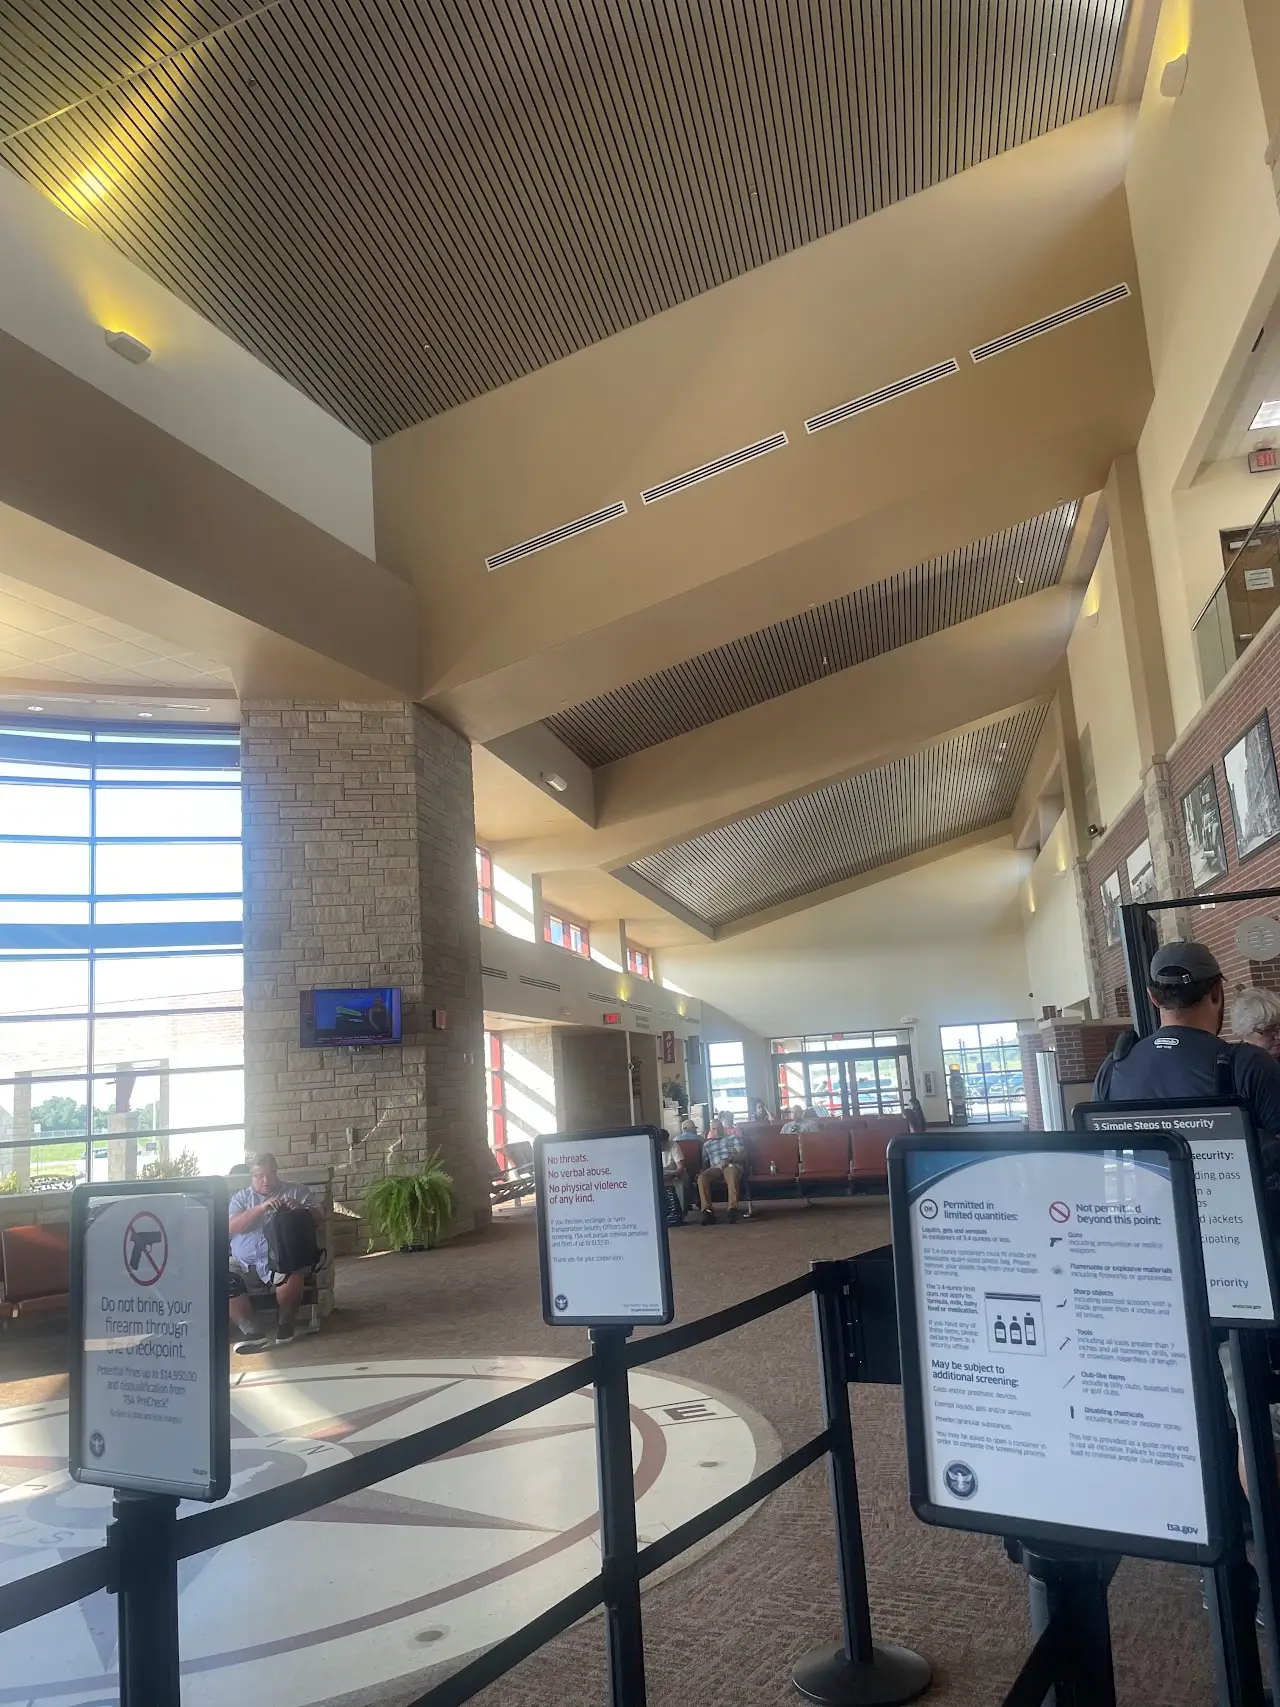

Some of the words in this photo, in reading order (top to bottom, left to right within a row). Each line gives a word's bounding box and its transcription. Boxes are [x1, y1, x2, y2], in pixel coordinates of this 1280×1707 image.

[665, 1033, 673, 1061] AVIS
[1101, 1121, 1132, 1130] Simple
[1134, 1121, 1160, 1130] Steps
[1162, 1120, 1172, 1129] to
[1174, 1119, 1214, 1129] Security
[548, 1156, 558, 1164] No
[560, 1154, 588, 1163] threats.
[1191, 1151, 1234, 1161] security:
[548, 1170, 559, 1178] No
[561, 1168, 585, 1178] verbal
[586, 1168, 612, 1176] abuse.
[1194, 1171, 1216, 1180] ding
[1218, 1172, 1240, 1181] pass
[549, 1184, 560, 1193] No
[562, 1182, 592, 1193] physical
[594, 1181, 628, 1190] violence
[1206, 1188, 1212, 1196] a
[550, 1196, 558, 1204] of
[576, 1194, 594, 1202] kind.
[944, 1200, 984, 1210] Permitted
[986, 1202, 994, 1210] in
[1076, 1204, 1092, 1212] Not
[944, 1210, 973, 1220] limited
[974, 1212, 1018, 1221] quantities:
[1078, 1214, 1111, 1224] beyond
[1114, 1215, 1131, 1224] this
[1134, 1216, 1161, 1226] point:
[1209, 1214, 1243, 1224] jackets
[1201, 1234, 1240, 1245] cipating
[1210, 1278, 1248, 1289] priority
[101, 1296, 115, 1311] Do
[118, 1298, 134, 1312] not
[138, 1297, 164, 1316] bring
[168, 1300, 192, 1316] your
[106, 1317, 142, 1334] firearm
[146, 1319, 188, 1338] through
[126, 1340, 186, 1359] checkpoint.
[932, 1360, 950, 1370] May
[952, 1361, 962, 1370] be
[964, 1362, 994, 1374] subject
[996, 1365, 1004, 1374] to
[152, 1370, 158, 1379] to
[932, 1371, 974, 1382] additional
[976, 1374, 1019, 1388] screening:
[170, 1384, 186, 1394] from
[123, 1394, 135, 1405] TSA
[662, 1404, 717, 1420] E
[1167, 1523, 1198, 1534] tsa.gov
